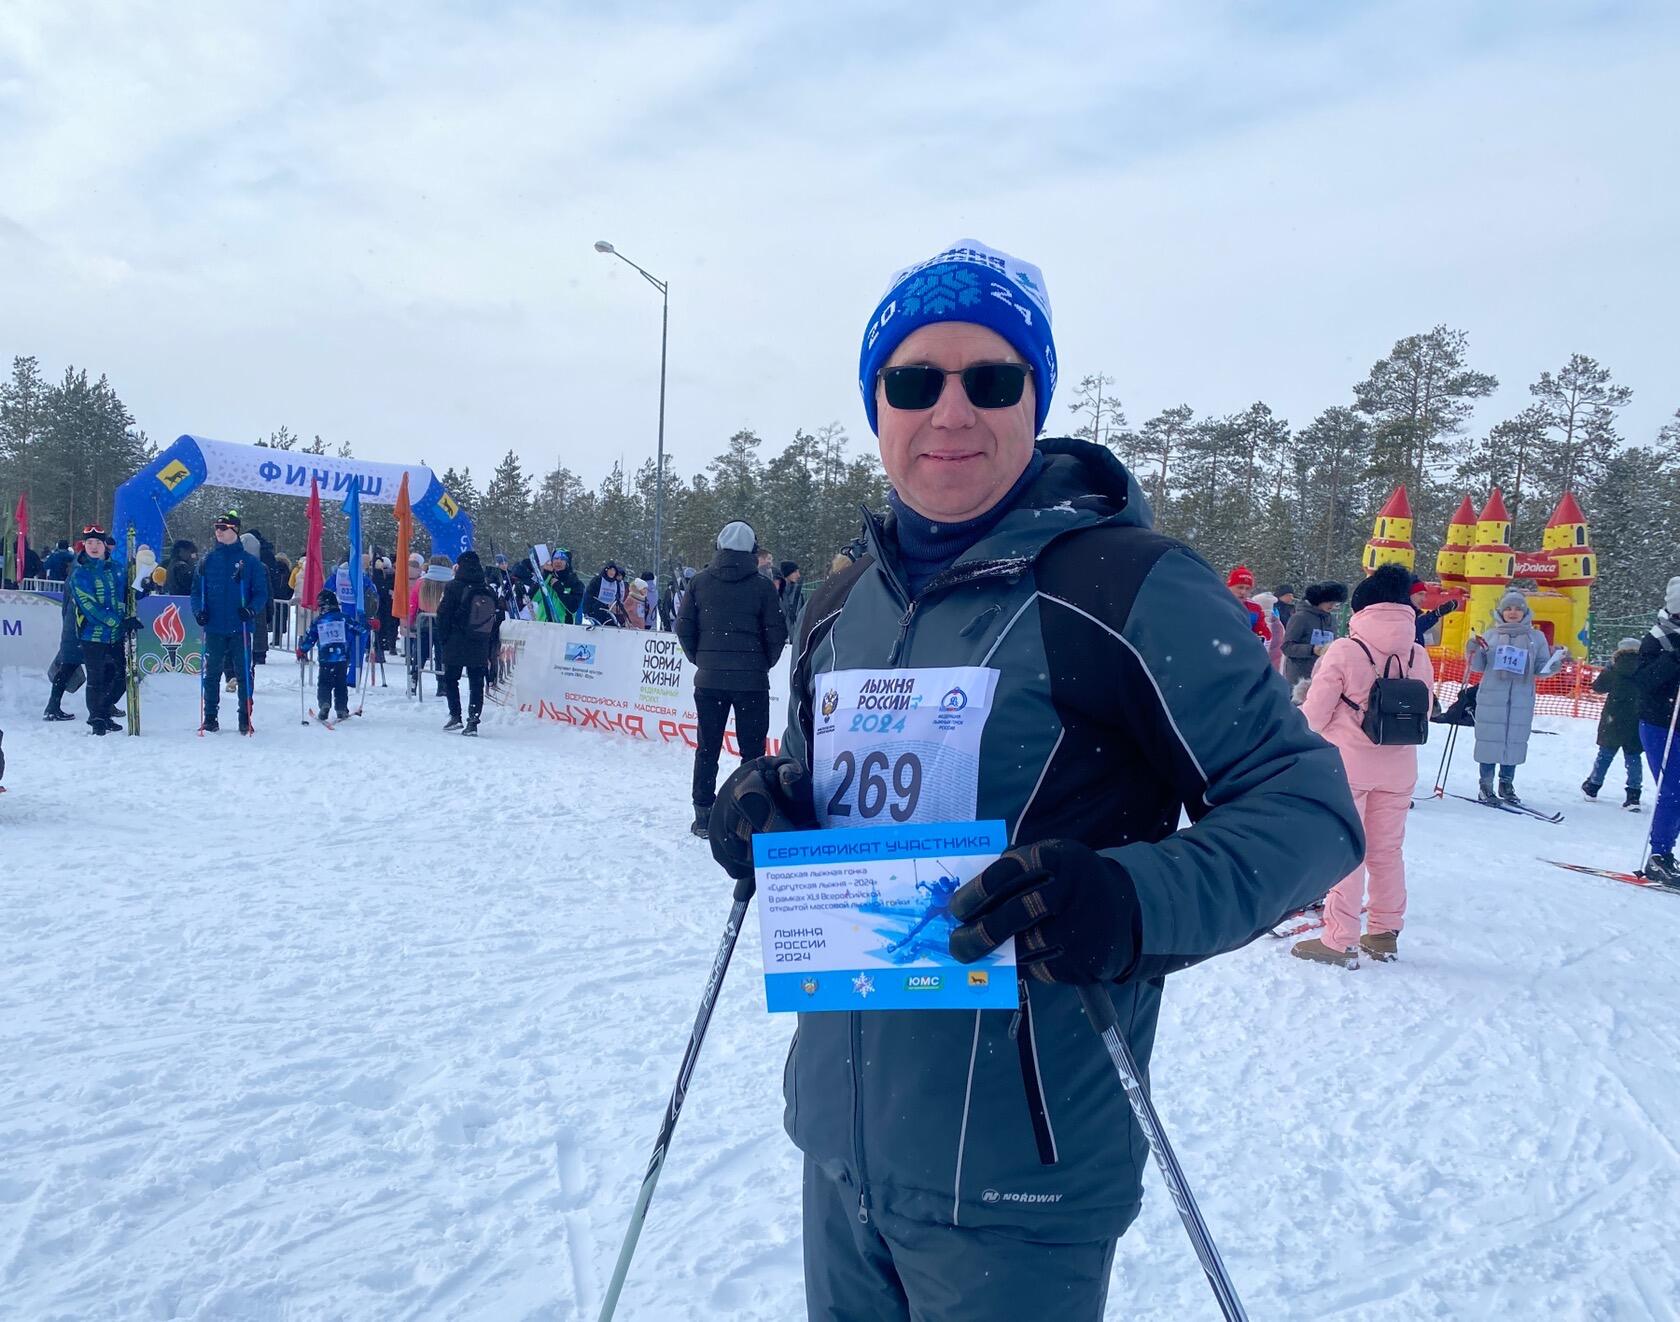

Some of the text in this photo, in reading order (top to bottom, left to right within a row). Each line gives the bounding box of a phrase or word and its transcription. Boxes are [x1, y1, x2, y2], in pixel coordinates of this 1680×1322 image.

[259, 461, 383, 496] ФИНИШ
[1515, 561, 1556, 574] irPalace
[644, 639, 678, 656] СПОРТ
[642, 655, 682, 672] НОРМА
[1502, 655, 1518, 667] 114
[641, 670, 681, 688] ЖИЗНИ
[859, 678, 915, 694] ЛЫЖНЯ
[565, 692, 628, 709] ВСЕРОССИЙСКАЯ
[634, 703, 677, 717] МАССОВАЯ
[857, 695, 911, 710] РОССИИ
[848, 713, 907, 733] 2024
[827, 750, 922, 822] 269
[767, 836, 990, 860] СЕРТИФИКАТ УЧАСТНИКА
[766, 868, 868, 880] Городская лыжная гонка
[819, 881, 847, 889] лыжня
[768, 895, 775, 903] В
[775, 895, 805, 904] рамках
[821, 890, 881, 901] Всероссийской
[769, 903, 809, 912] открытой
[810, 902, 849, 910] массовой
[774, 927, 823, 938] ЛЫЖНЯ
[774, 939, 826, 950] РОССИИ
[775, 952, 811, 962] 2024
[908, 976, 940, 986] ЮМС
[1002, 1192, 1063, 1203] NORDWAY
